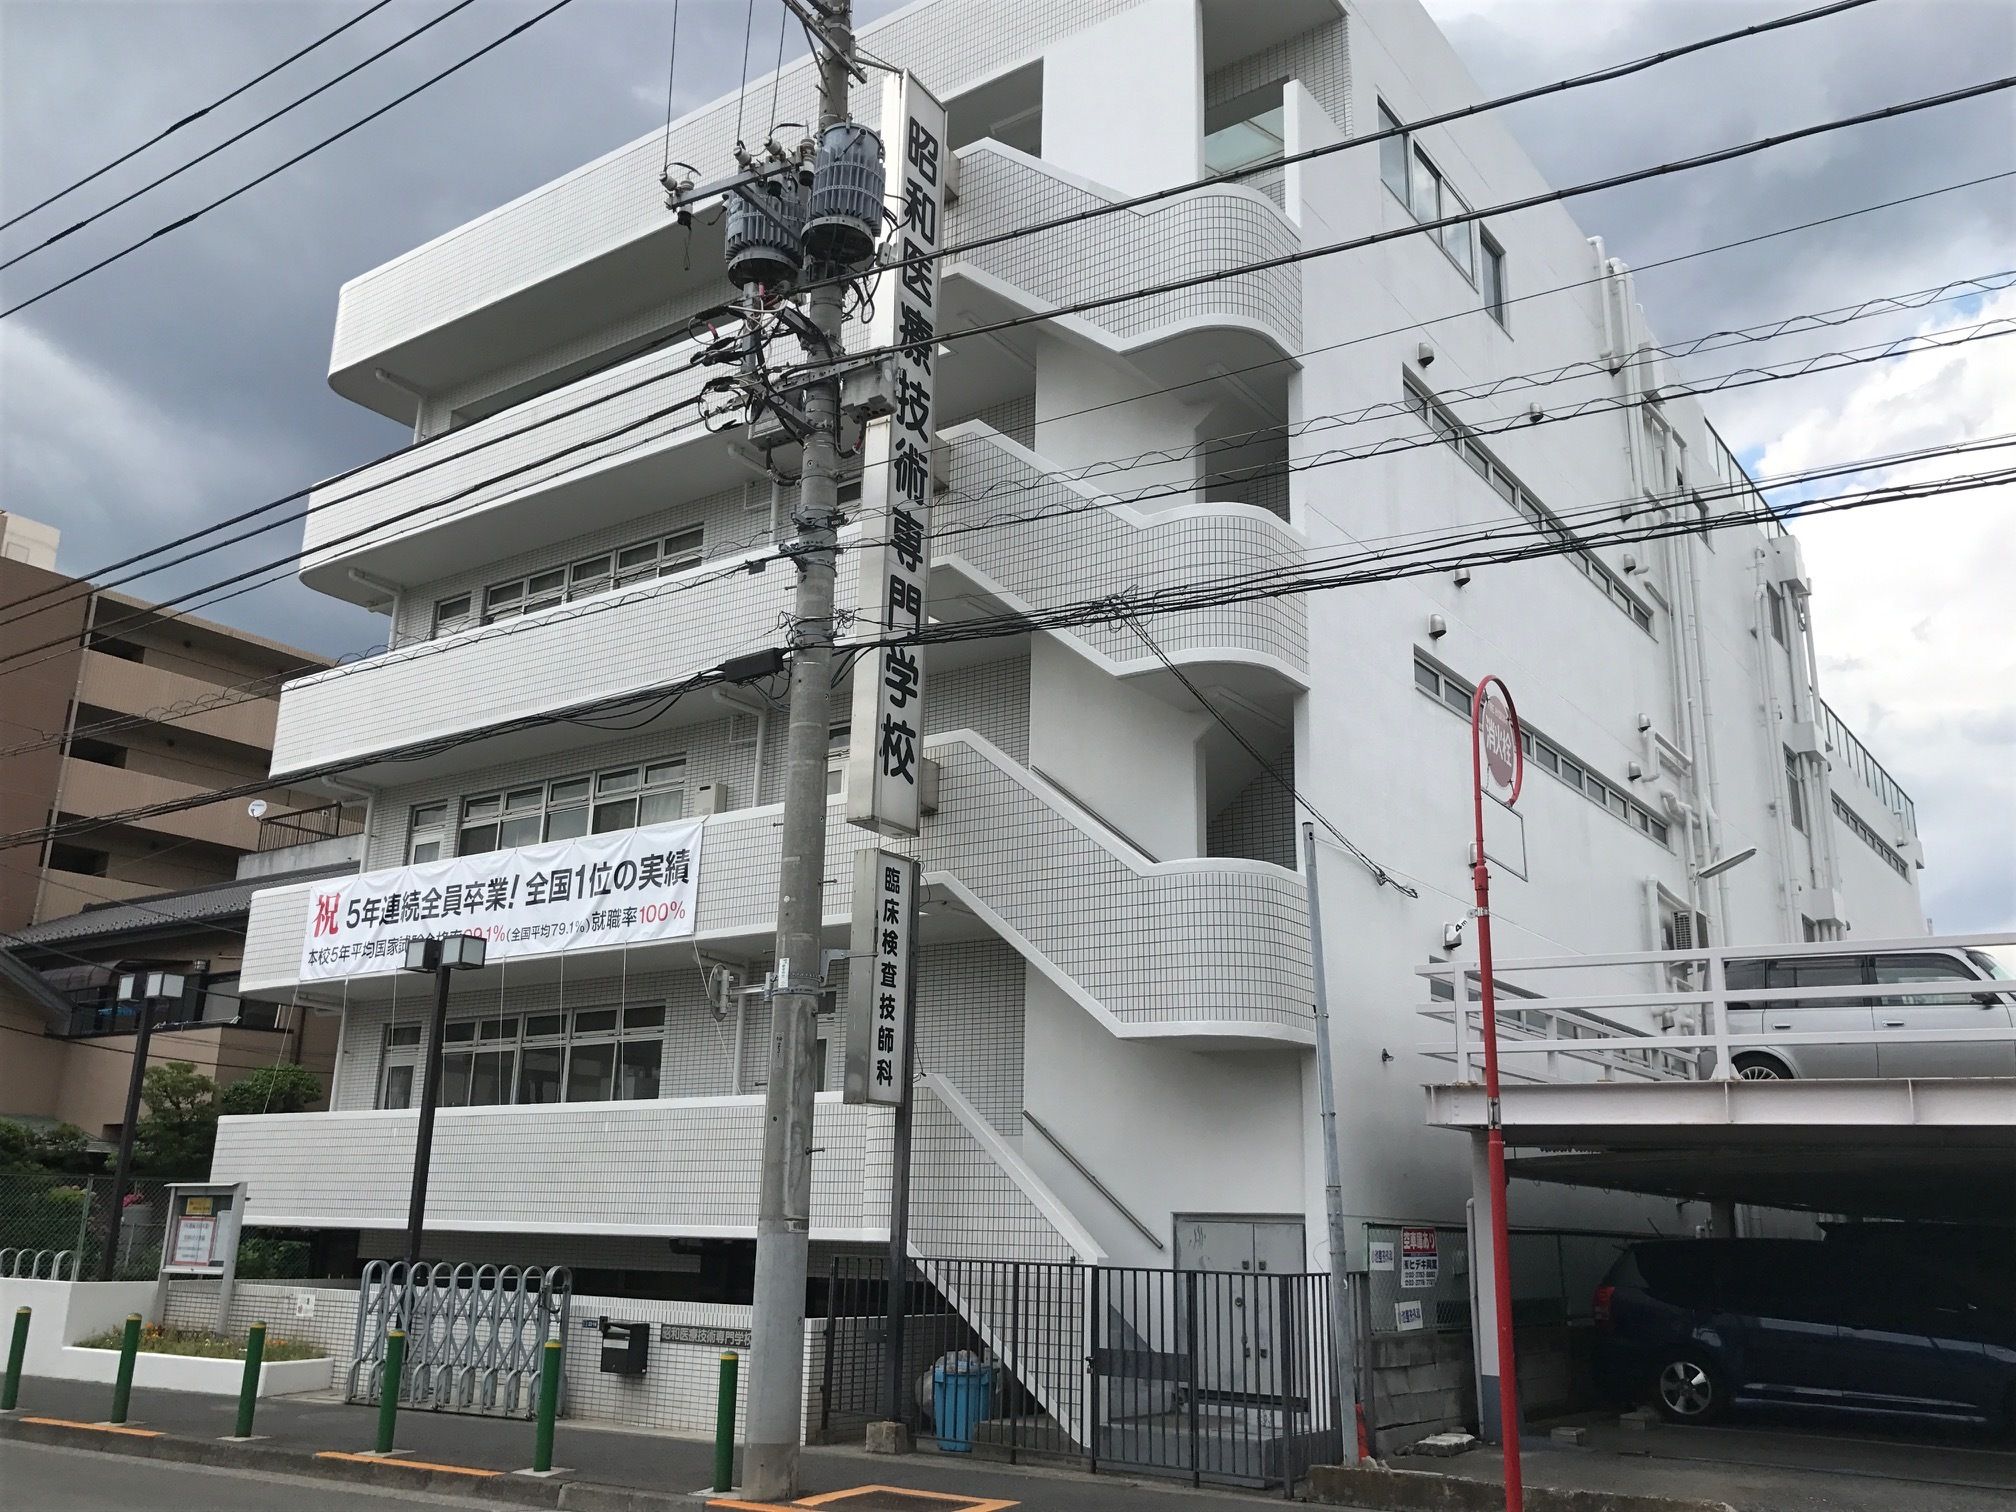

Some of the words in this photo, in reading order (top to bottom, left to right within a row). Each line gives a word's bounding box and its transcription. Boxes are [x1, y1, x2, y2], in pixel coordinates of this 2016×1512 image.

[879, 115, 938, 785] 昭和医療技術専門学校
[1485, 714, 1512, 768] 消火栓
[312, 892, 339, 938] 祝
[876, 866, 901, 1087] 臨床検査技師科
